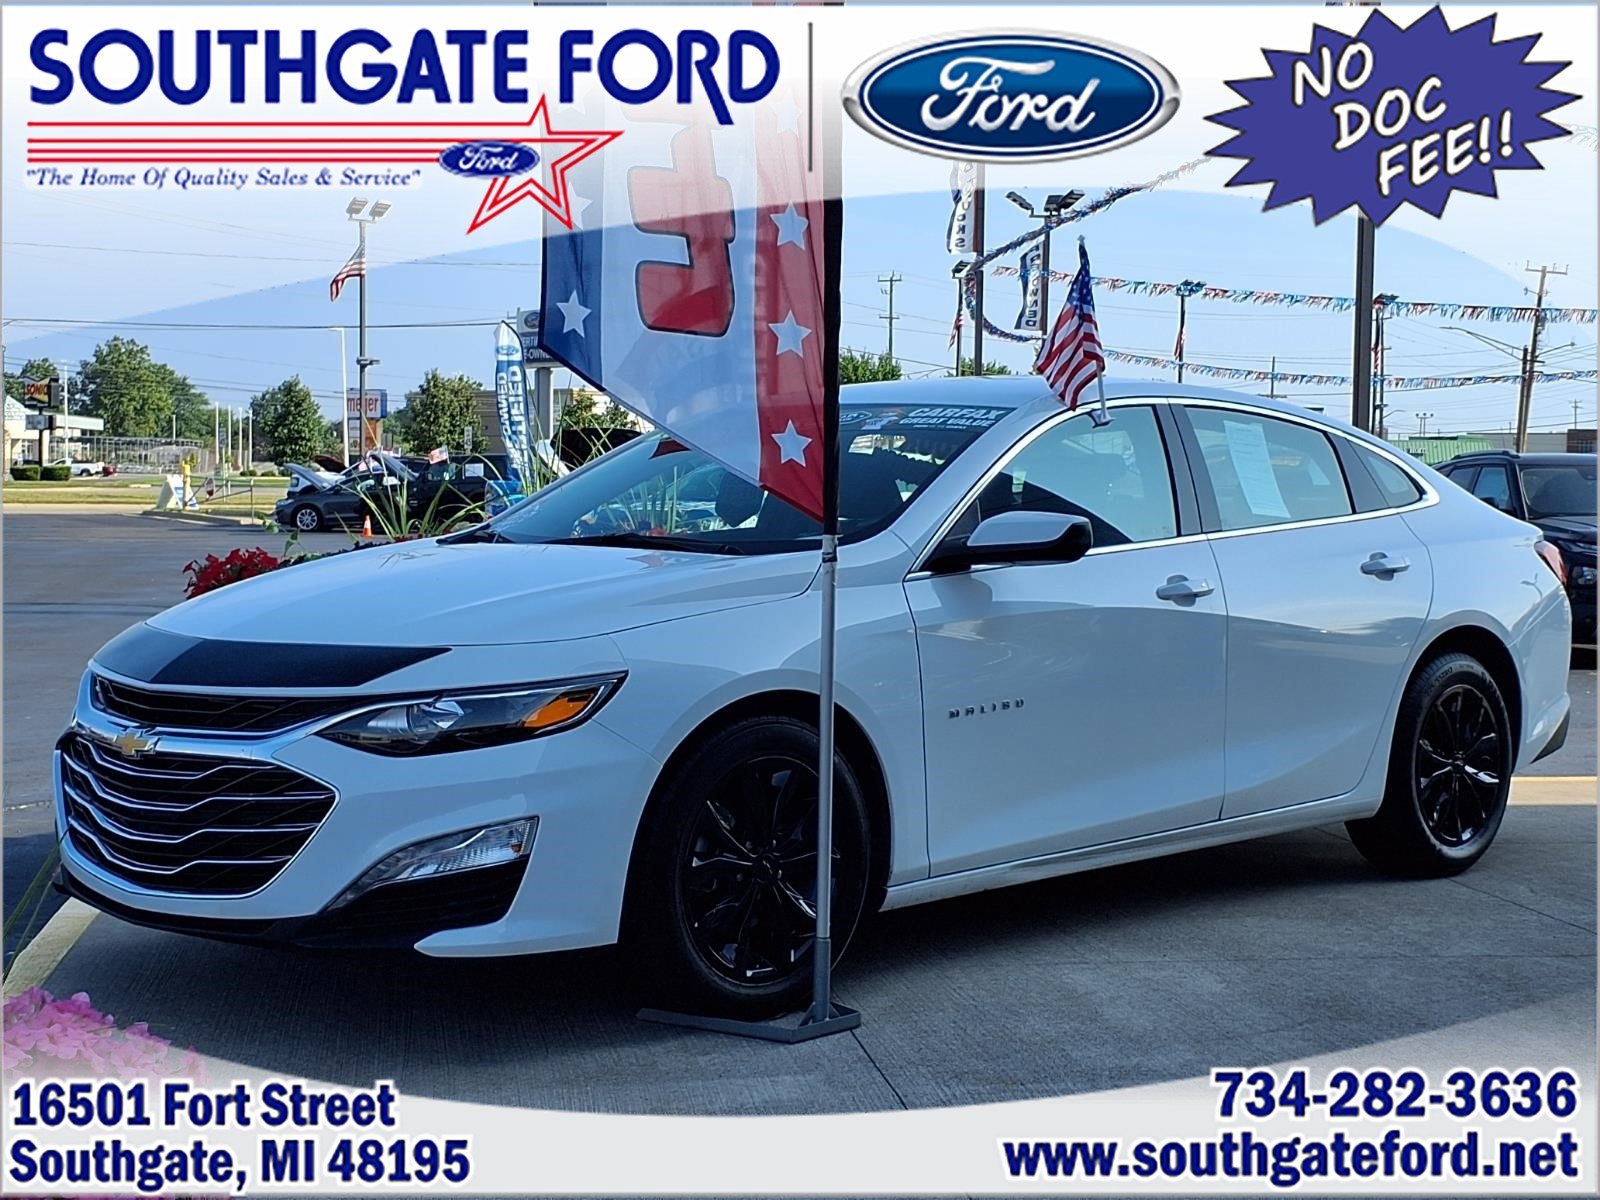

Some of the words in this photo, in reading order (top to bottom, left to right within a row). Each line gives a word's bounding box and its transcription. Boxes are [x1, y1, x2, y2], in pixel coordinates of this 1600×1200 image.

[346, 392, 379, 417] mejer
[908, 406, 1006, 420] CARFAX
[899, 416, 947, 425] GREAT
[948, 417, 996, 427] VALUE
[948, 697, 1025, 719] MALIBU
